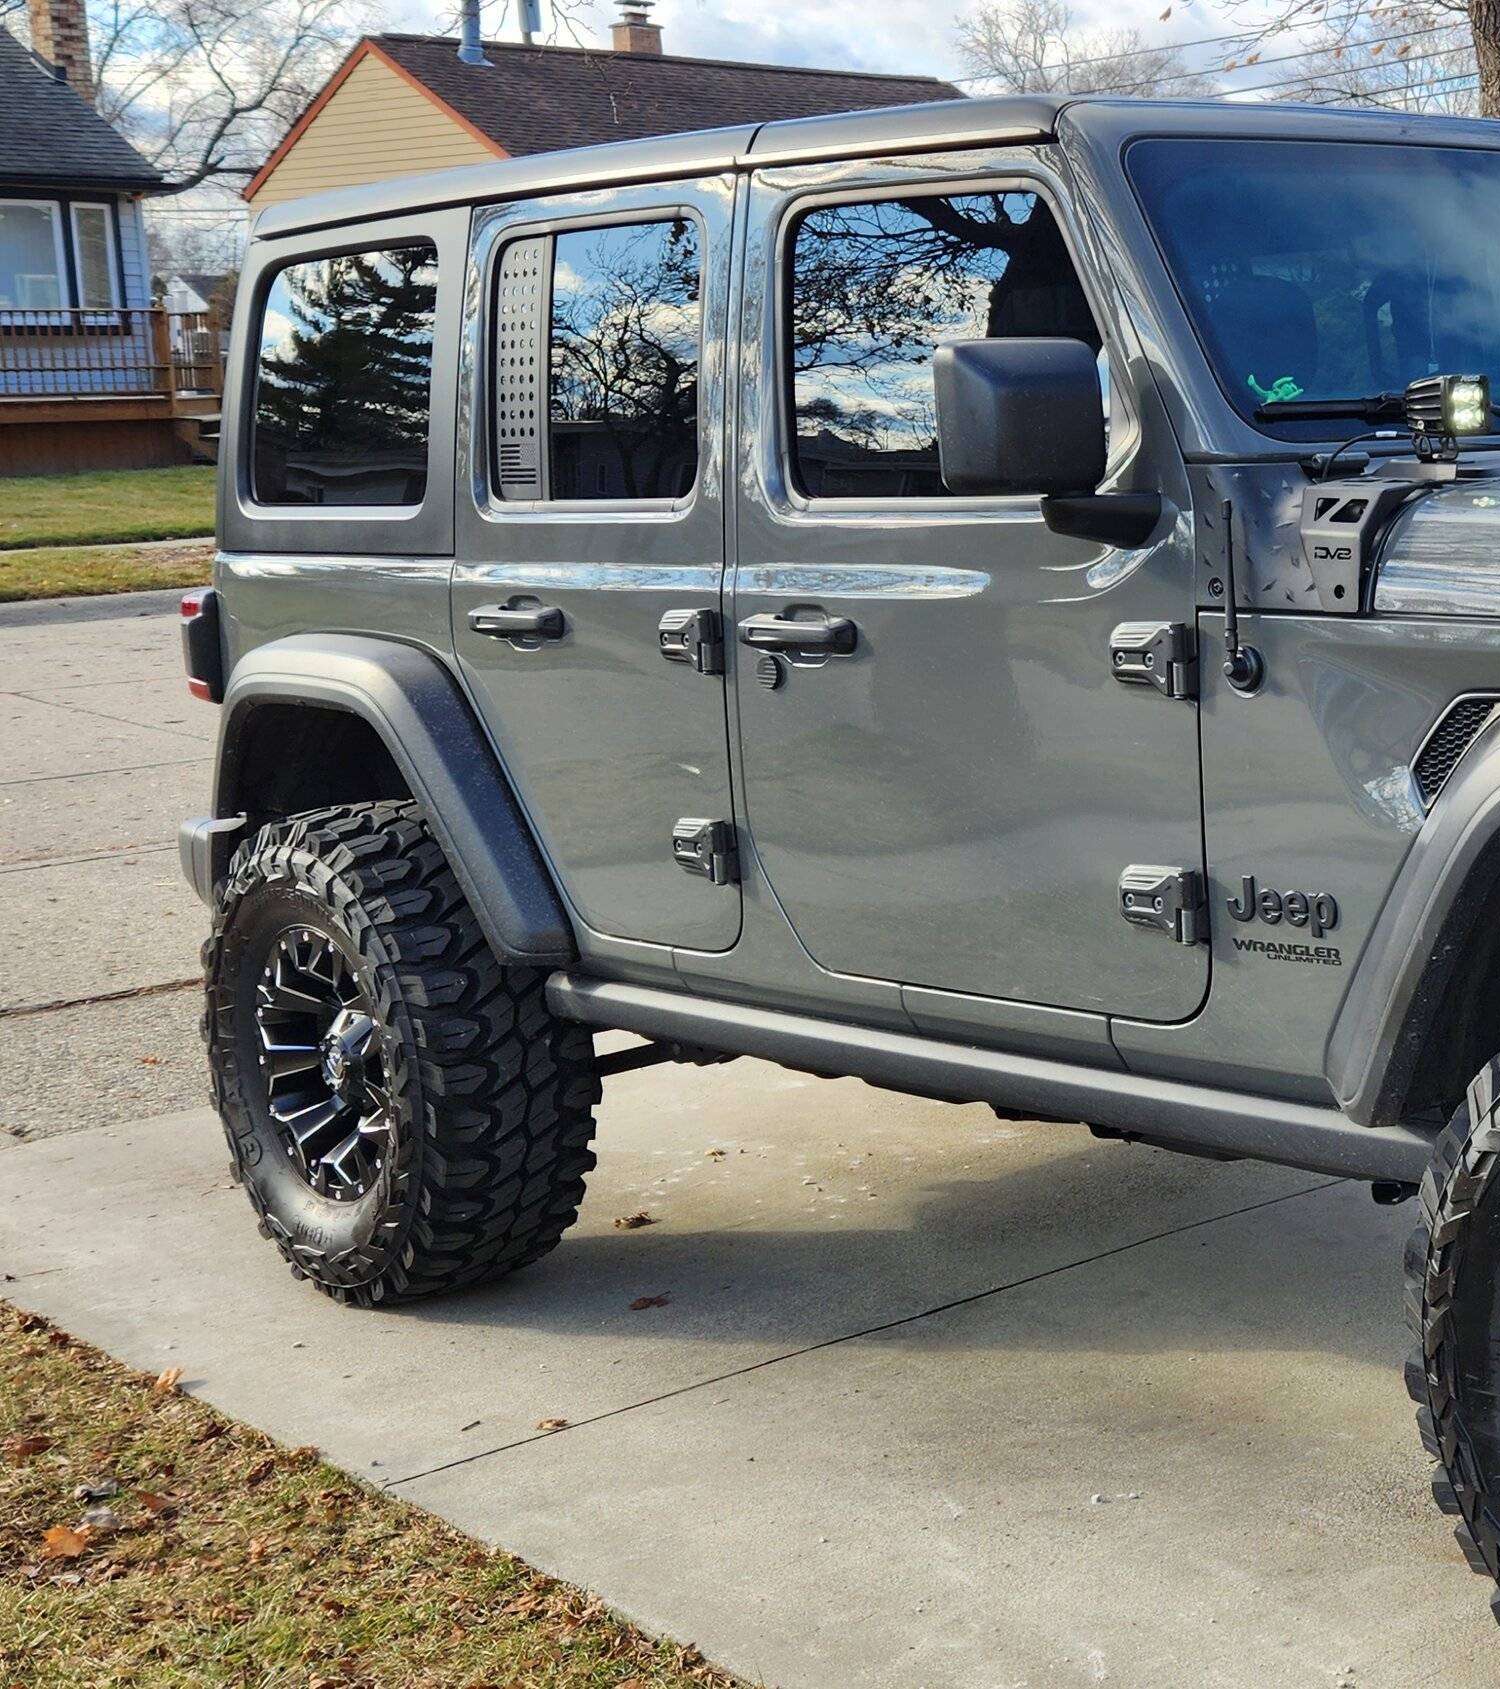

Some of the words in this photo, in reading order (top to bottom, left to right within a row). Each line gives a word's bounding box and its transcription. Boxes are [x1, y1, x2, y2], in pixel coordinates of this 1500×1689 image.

[1227, 875, 1338, 938] Jeep
[1233, 937, 1341, 960] WRANGLER
[1267, 953, 1342, 966] UNLIMITED
